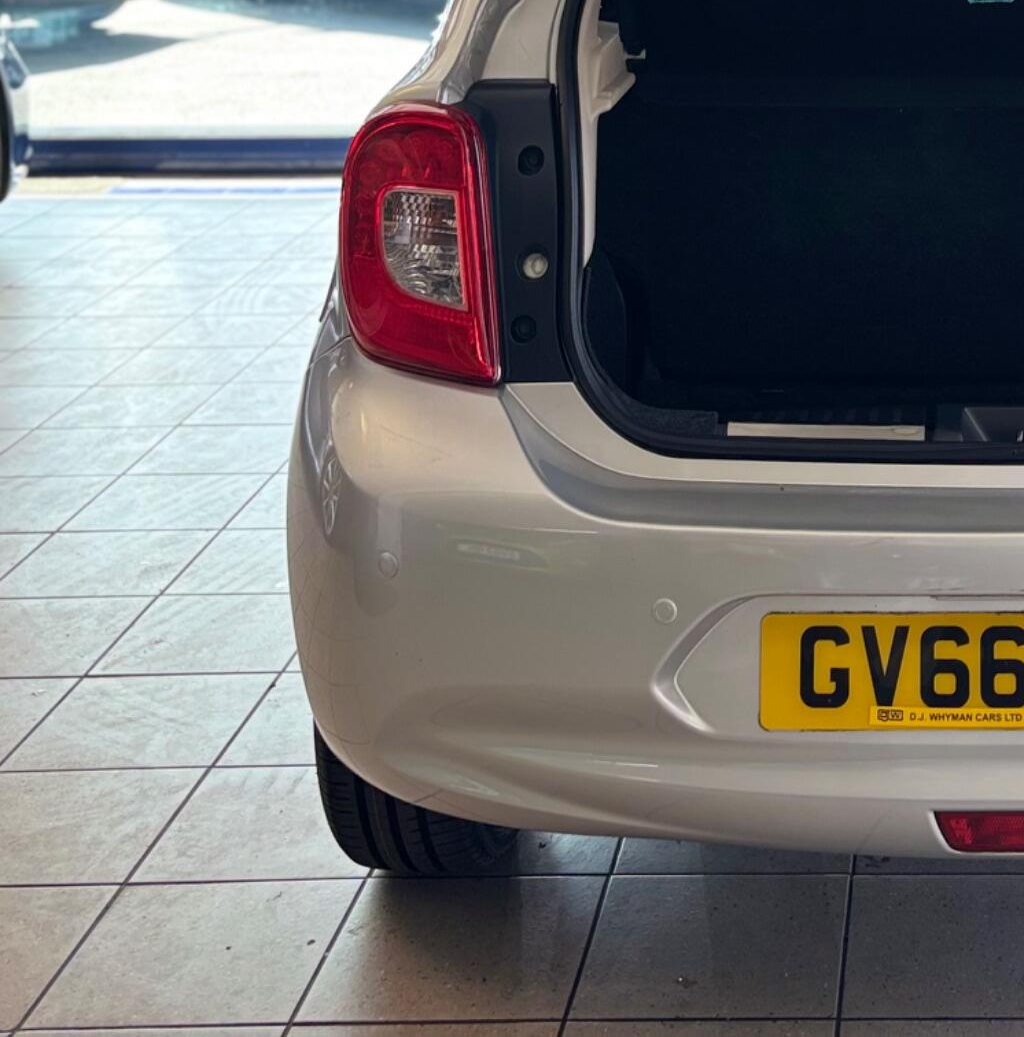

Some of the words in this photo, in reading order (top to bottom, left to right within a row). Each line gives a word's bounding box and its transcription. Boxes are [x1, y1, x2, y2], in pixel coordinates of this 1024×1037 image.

[929, 712, 973, 722] WHYMAN
[975, 712, 1002, 722] CARS
[1004, 712, 1023, 722] LTD
